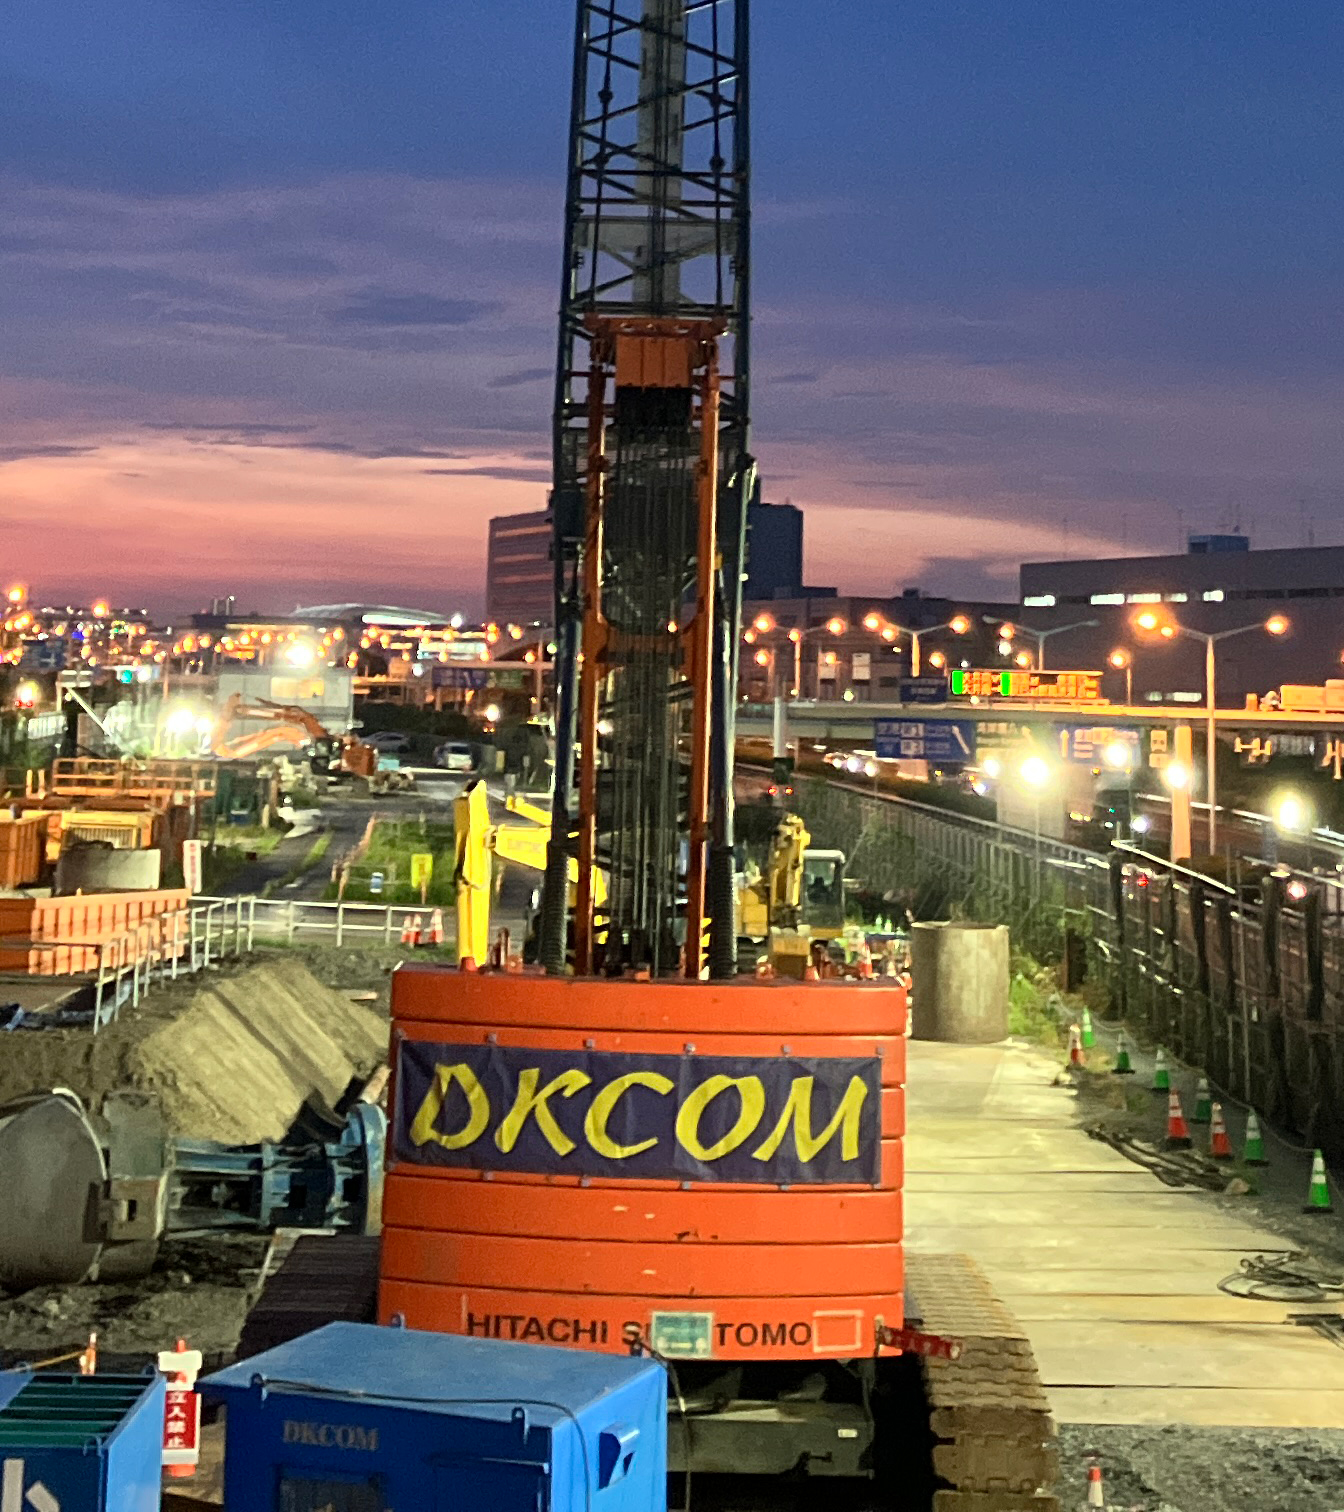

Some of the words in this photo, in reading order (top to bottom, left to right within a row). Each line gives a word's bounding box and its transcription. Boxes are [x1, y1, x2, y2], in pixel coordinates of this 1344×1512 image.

[409, 1062, 869, 1164] DKCOM
[466, 1312, 609, 1345] HITACHI
[622, 1320, 812, 1348] STOMO
[283, 1419, 379, 1452] DKCOM
